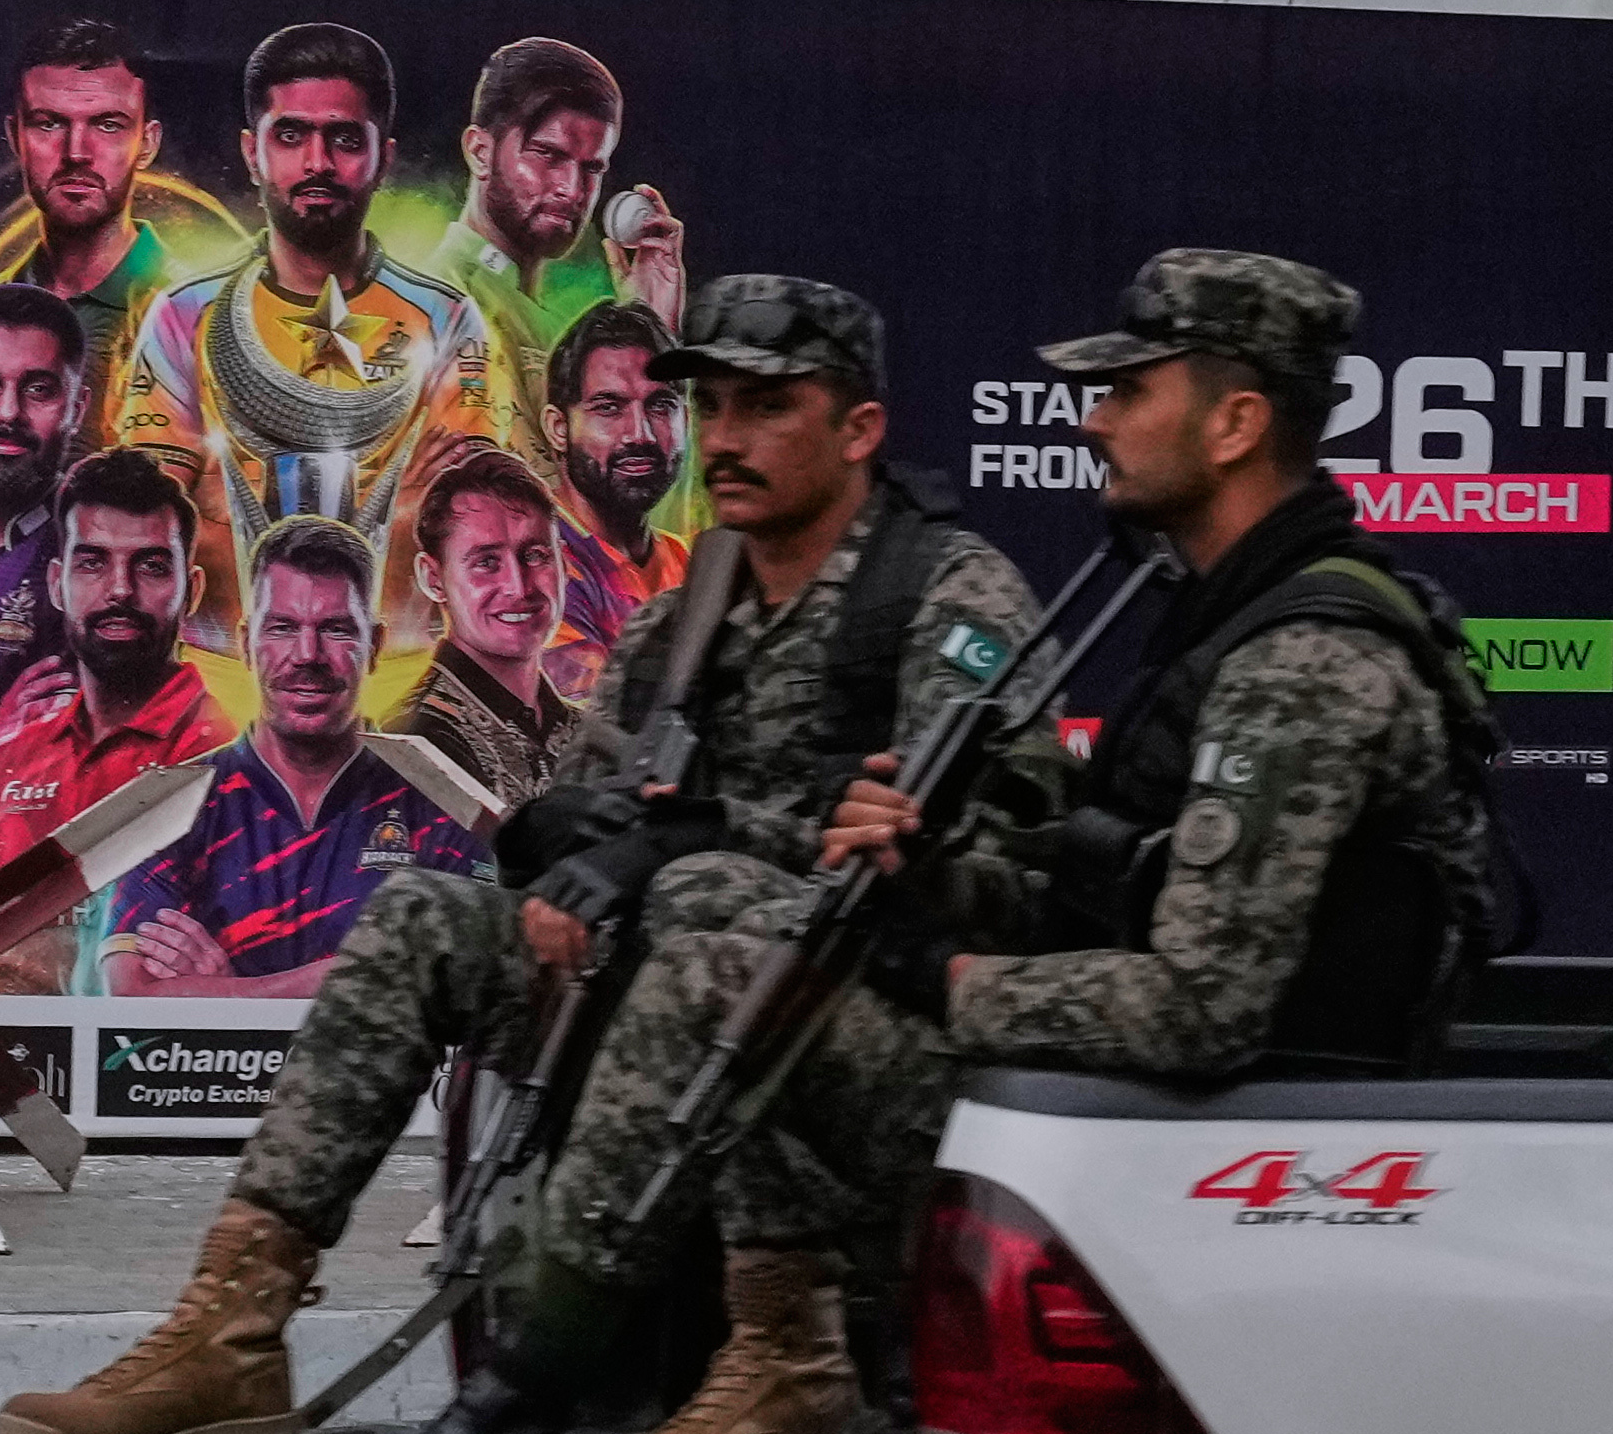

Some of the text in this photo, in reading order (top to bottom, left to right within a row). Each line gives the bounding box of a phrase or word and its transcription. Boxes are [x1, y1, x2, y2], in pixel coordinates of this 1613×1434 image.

[970, 443, 1111, 490] FROM
[1352, 481, 1579, 523] MARCH
[1510, 749, 1609, 766] SPORTS
[1585, 772, 1609, 785] HD
[103, 1034, 295, 1081] Xchange
[128, 1083, 275, 1107] Crypto Excha
[1187, 1149, 1445, 1208] 4x4
